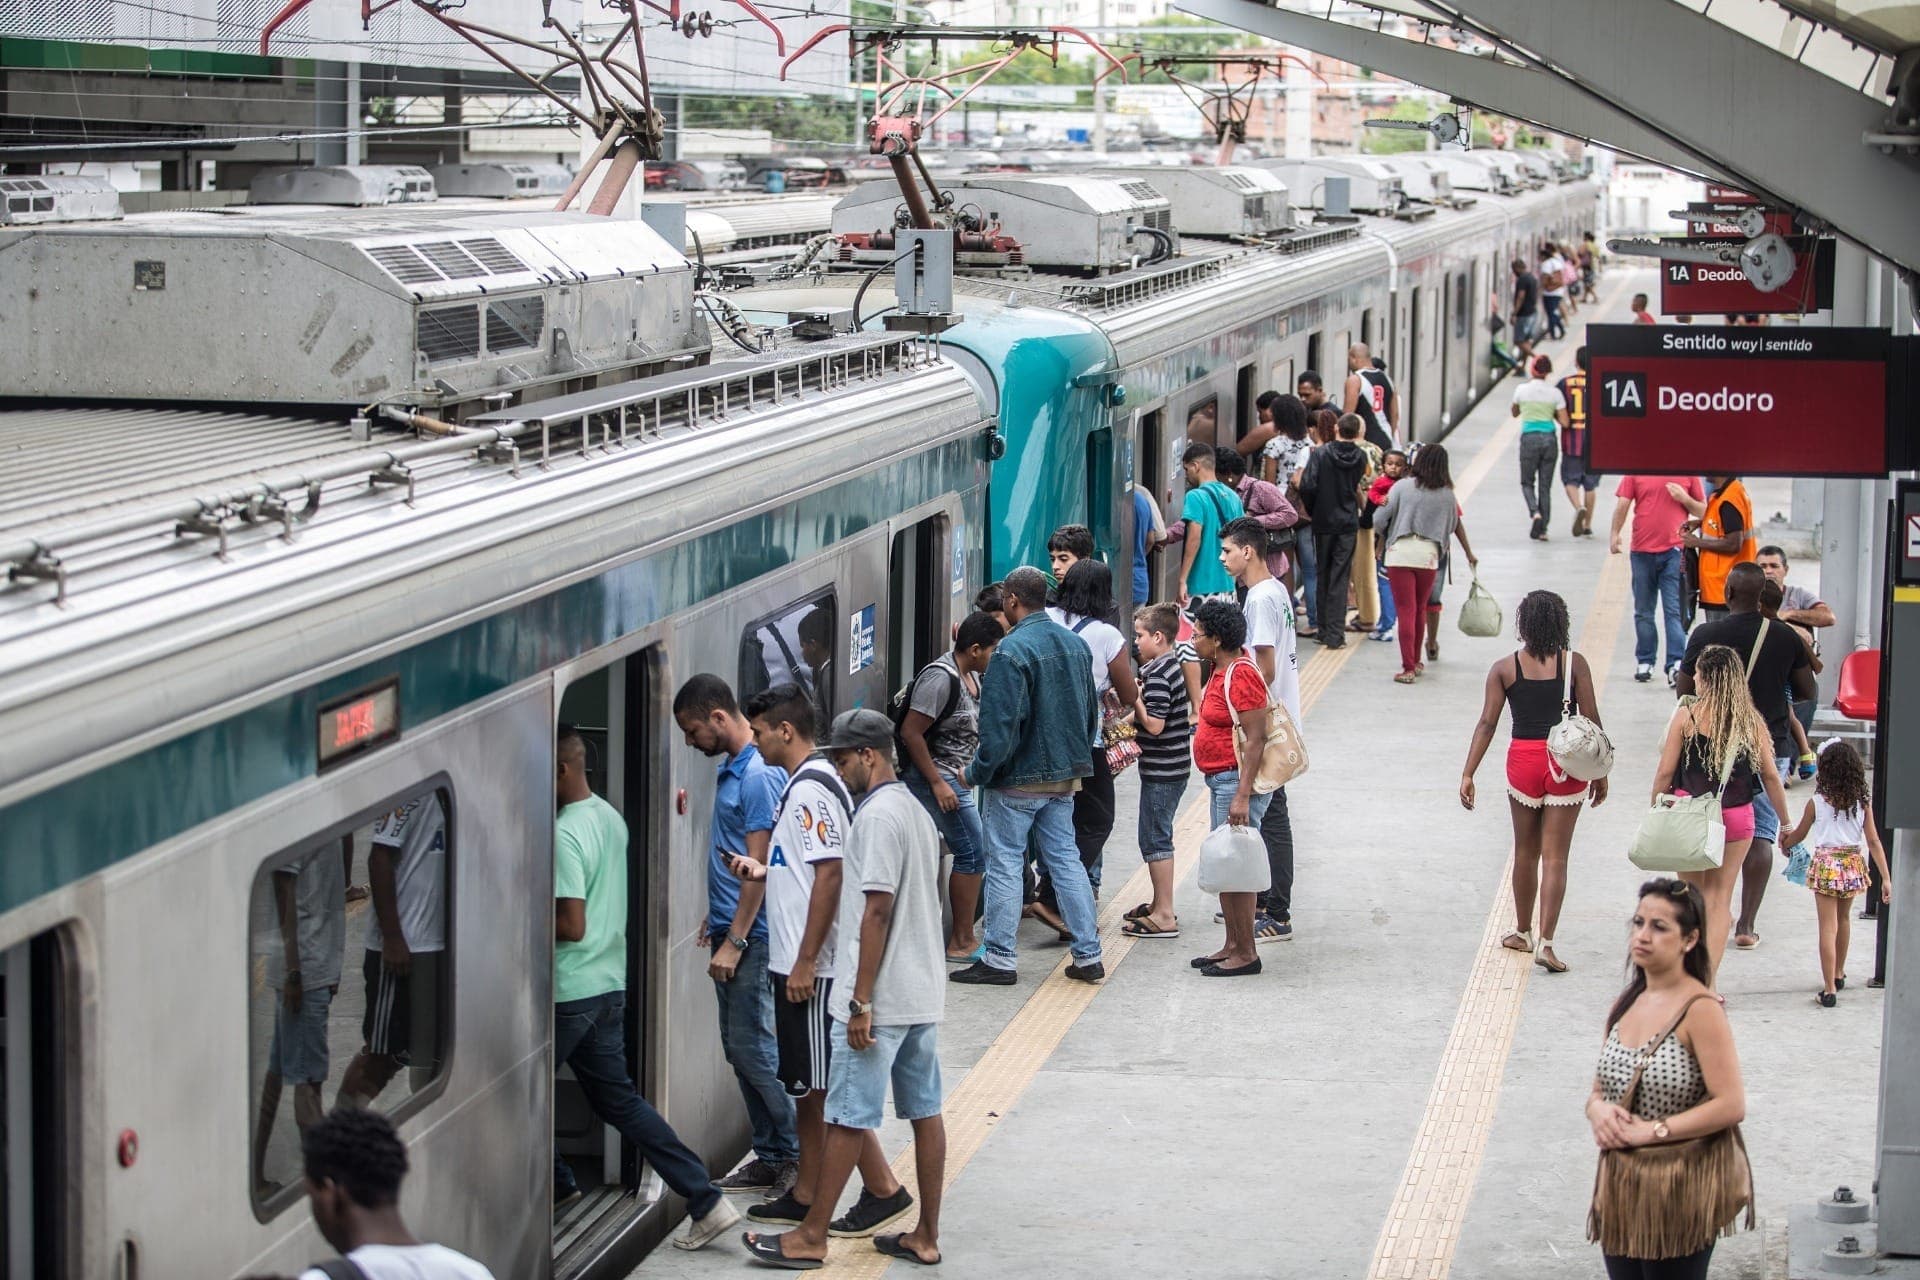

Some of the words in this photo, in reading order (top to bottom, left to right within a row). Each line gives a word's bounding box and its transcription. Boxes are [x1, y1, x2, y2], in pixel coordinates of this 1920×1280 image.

[1693, 222, 1707, 233] 1A
[1669, 265, 1690, 281] 1A
[1662, 333, 1727, 350] Sentido
[1731, 340, 1758, 353] way
[1765, 338, 1813, 352] sentido
[1373, 385, 1385, 412] 8
[1604, 379, 1642, 408] 1A
[1658, 386, 1774, 412] Deodoro
